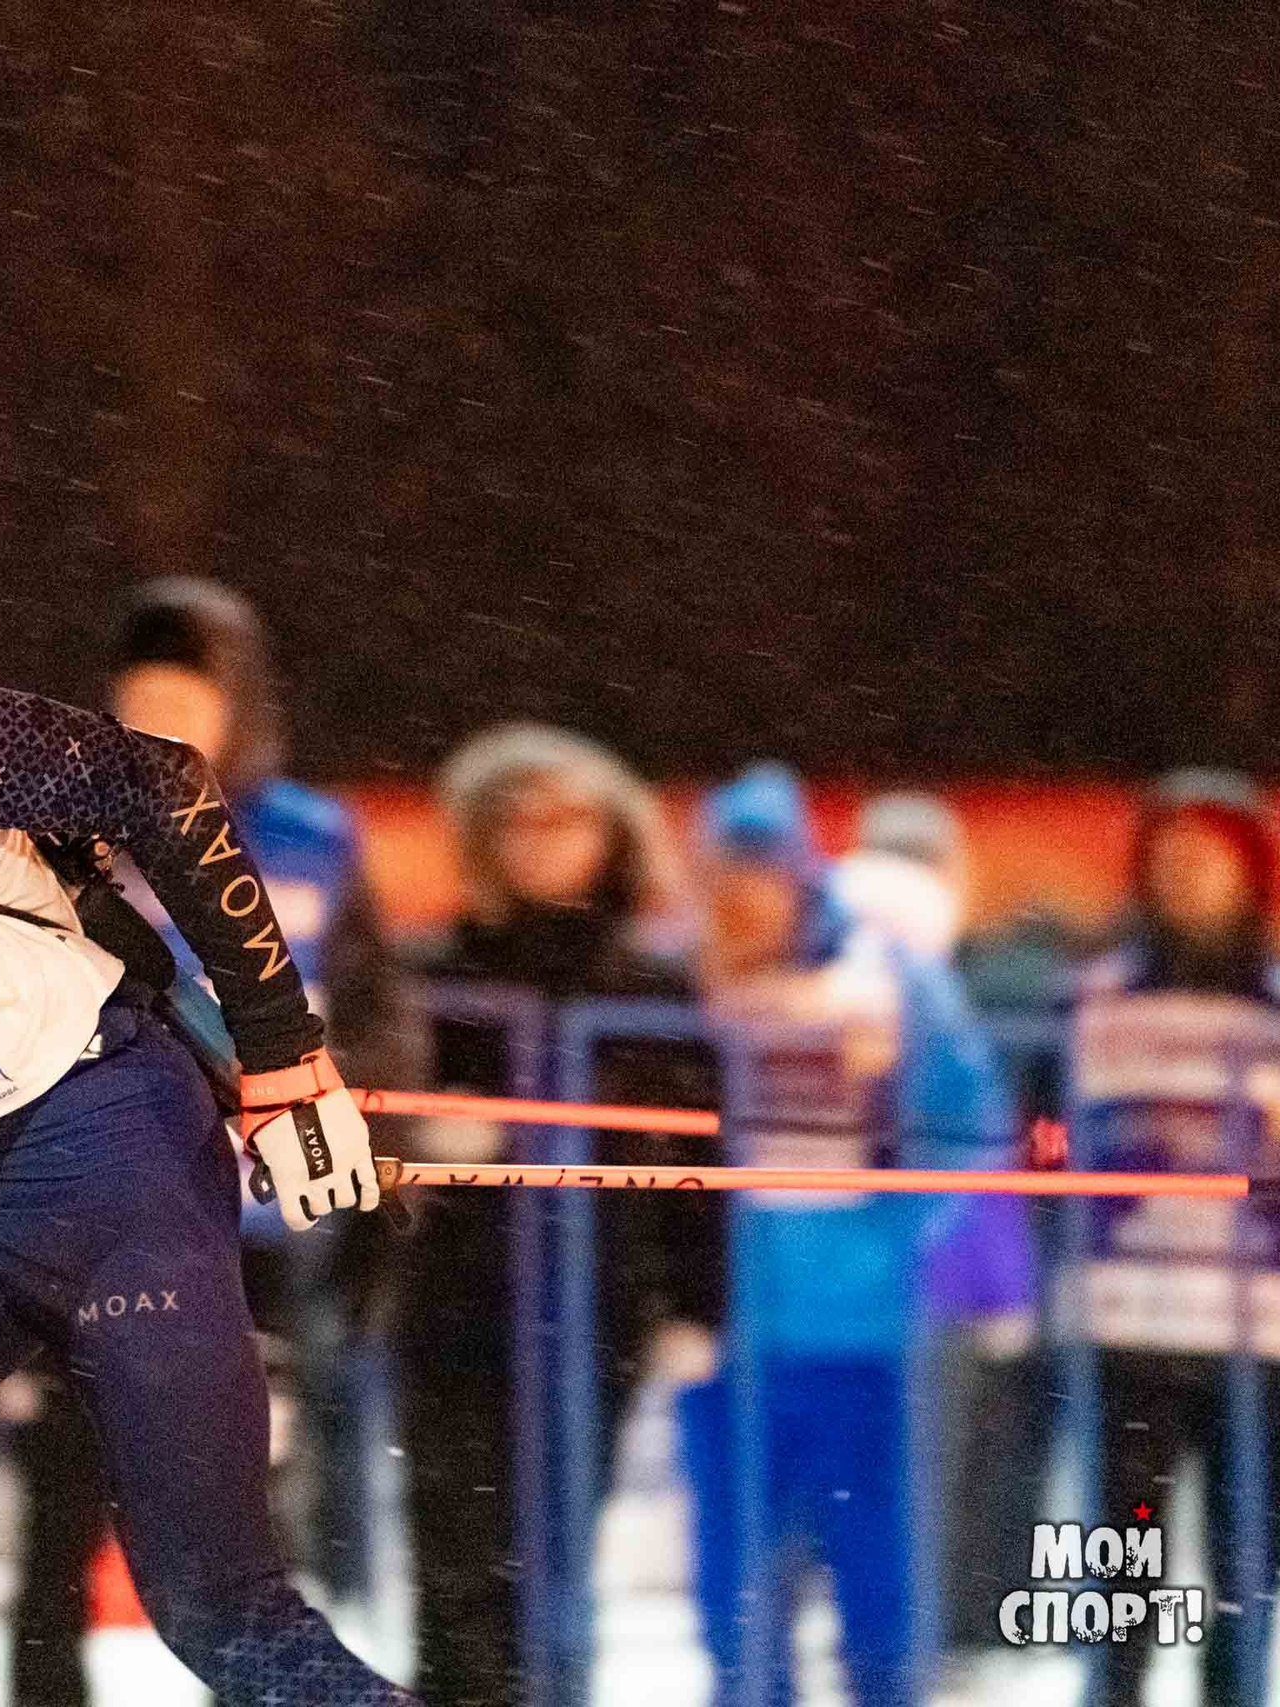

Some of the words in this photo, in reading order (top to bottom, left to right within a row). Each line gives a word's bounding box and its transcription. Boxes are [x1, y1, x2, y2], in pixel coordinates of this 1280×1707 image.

[170, 786, 291, 982] MOAX
[305, 1126, 326, 1171] MOAX
[77, 1290, 180, 1327] MOAX
